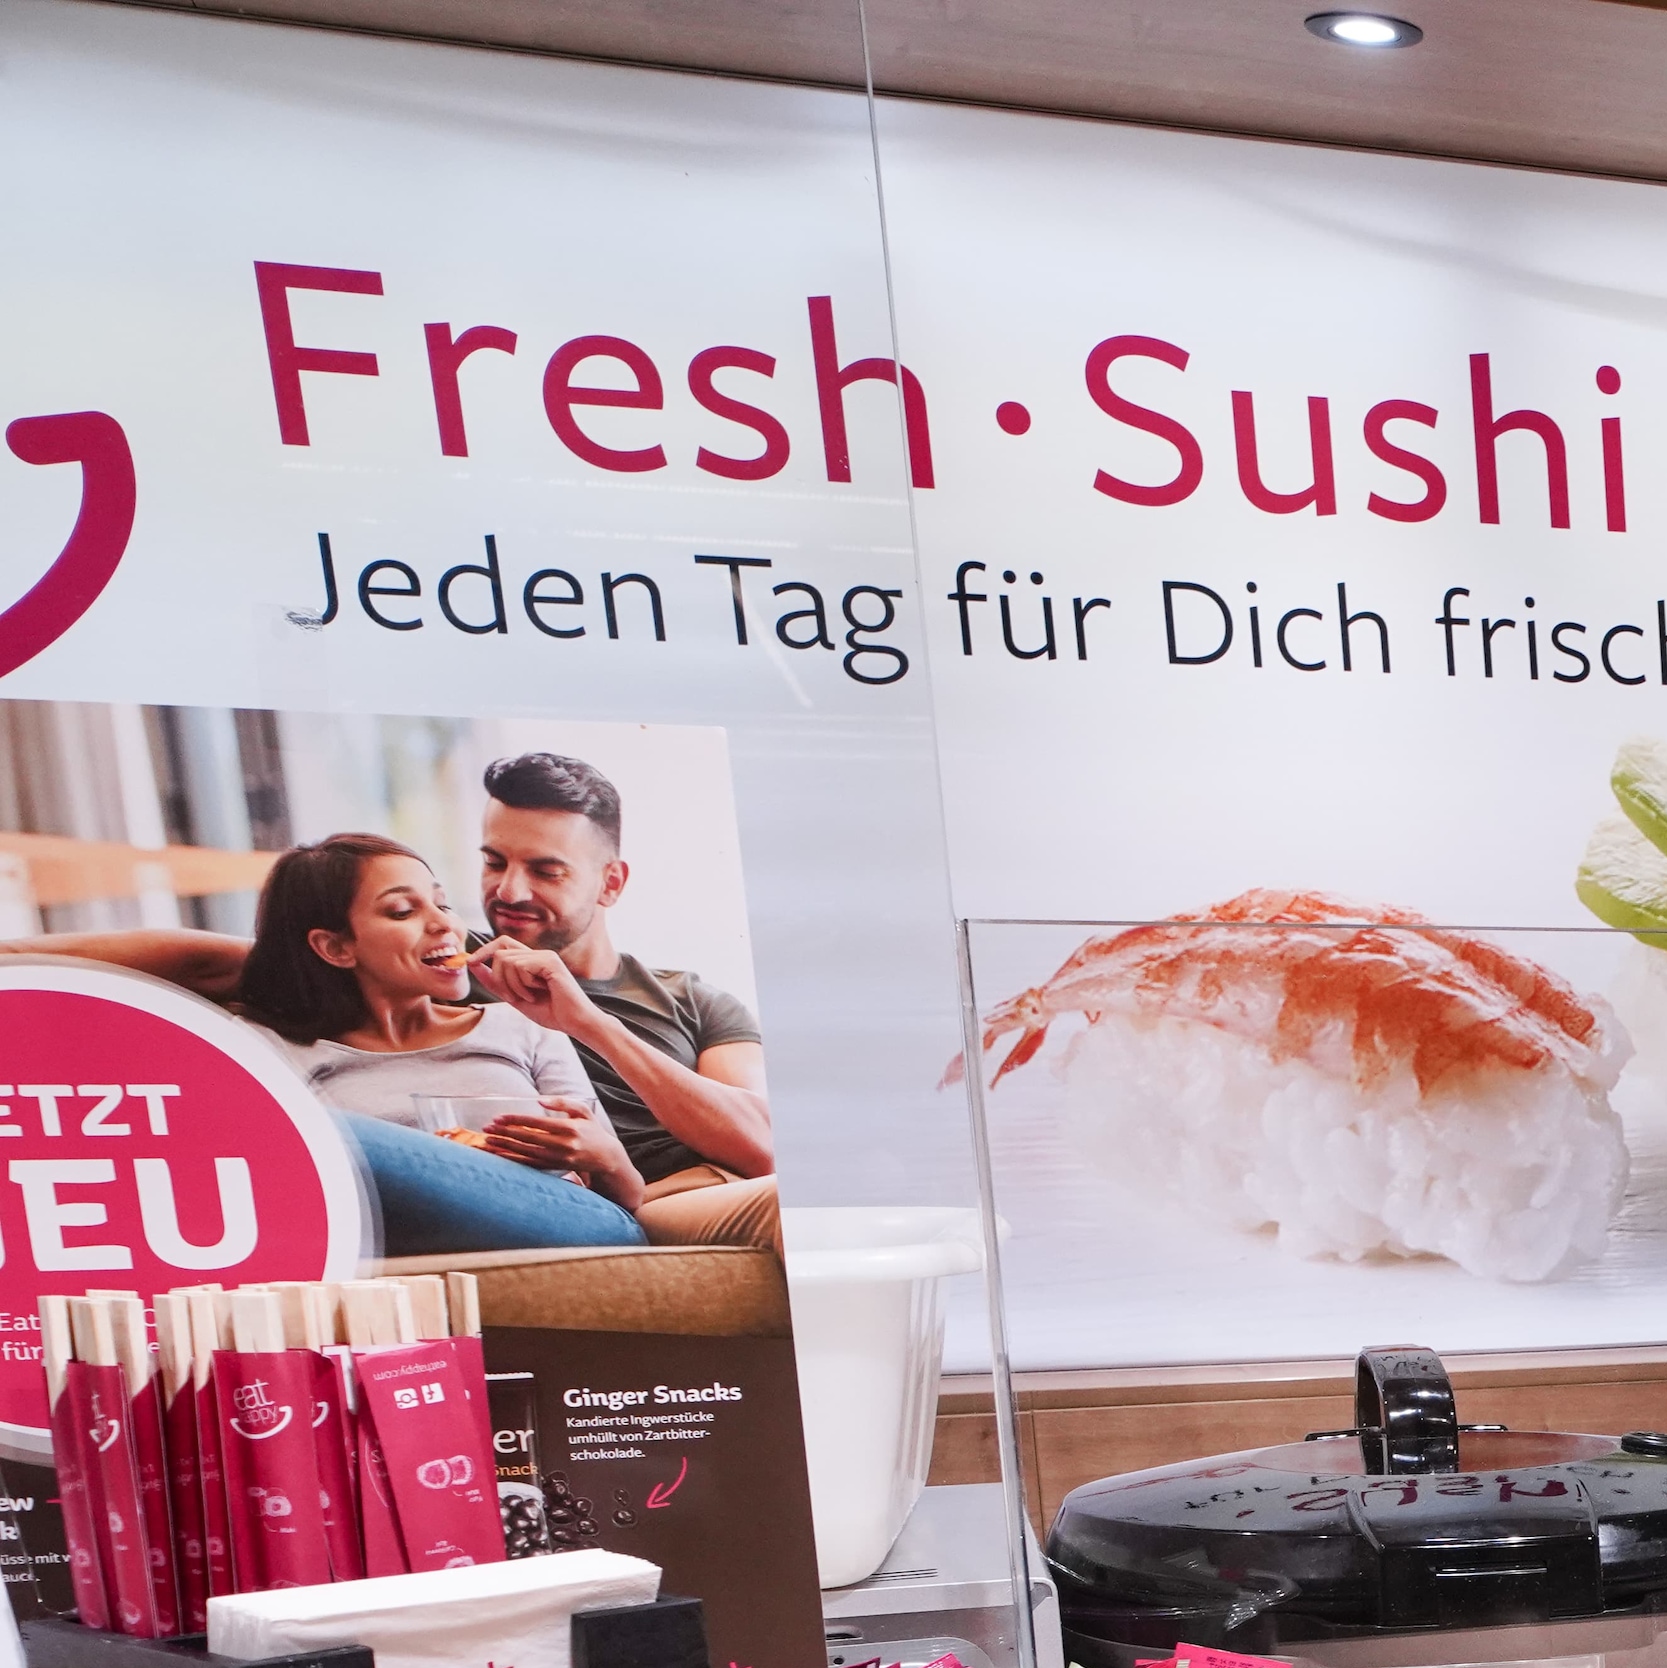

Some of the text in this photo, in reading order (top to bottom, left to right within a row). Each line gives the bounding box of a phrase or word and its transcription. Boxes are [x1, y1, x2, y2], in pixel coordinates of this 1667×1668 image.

[254, 260, 936, 490] Fresh
[1084, 334, 1628, 534] Sushi
[305, 531, 666, 642] Jeden
[694, 555, 908, 685] Tag
[947, 560, 1112, 662] für
[1162, 580, 1392, 675] Dich
[0, 1157, 259, 1273] EU
[2, 1340, 42, 1362] für
[373, 1360, 448, 1381] eathappy.com
[233, 1378, 270, 1410] eat
[563, 1382, 743, 1411] Ginger Snacks
[566, 1411, 715, 1428] Kandierte Ingwerstücke
[568, 1429, 711, 1445] umhüllt von Zartbitter-
[570, 1447, 646, 1461] schokolade.
